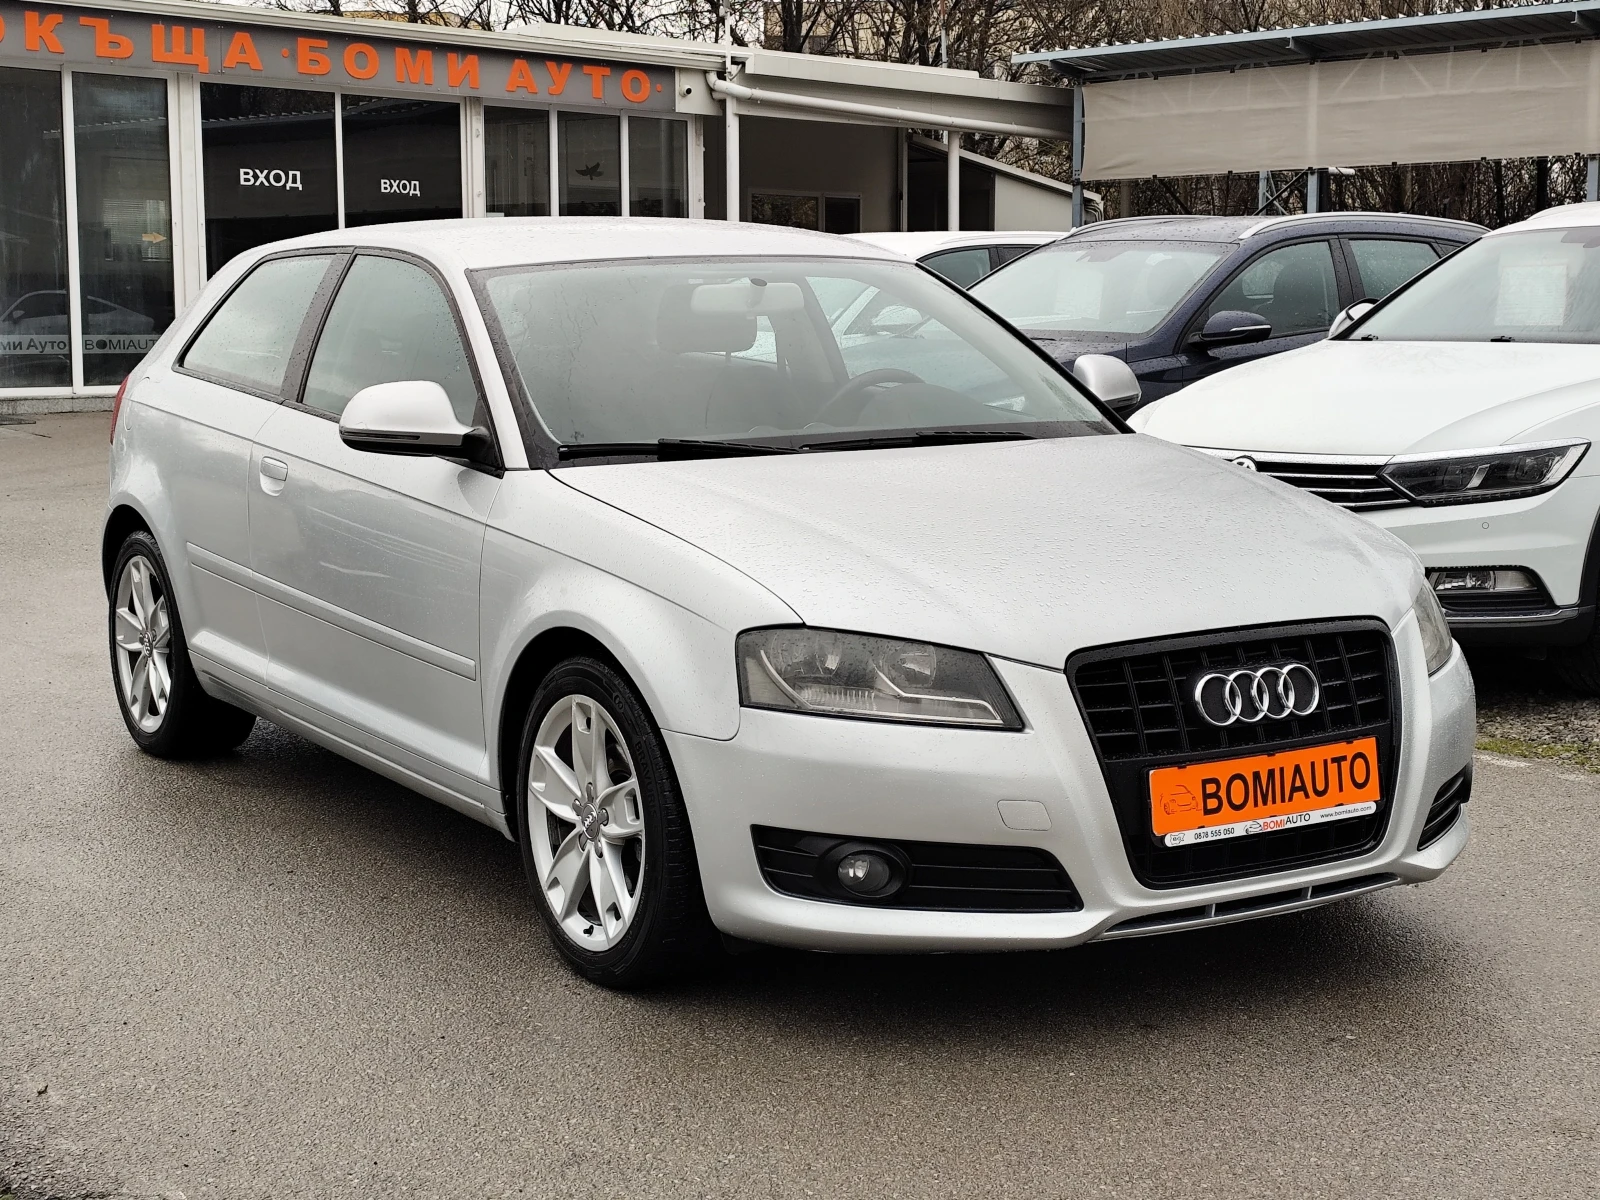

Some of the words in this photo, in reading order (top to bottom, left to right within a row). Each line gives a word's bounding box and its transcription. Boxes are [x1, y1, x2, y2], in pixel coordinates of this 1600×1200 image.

[0, 11, 263, 74] КЪЩА
[297, 37, 480, 89] БОМИ
[504, 59, 651, 103] АУТО
[239, 168, 303, 191] ВХОД
[380, 179, 421, 197] ВХОД
[26, 338, 67, 353] Ауто
[1201, 751, 1371, 816] BOMIAUTO
[1194, 832, 1209, 840] 0878
[1210, 830, 1222, 838] 555
[1223, 827, 1235, 836] 050
